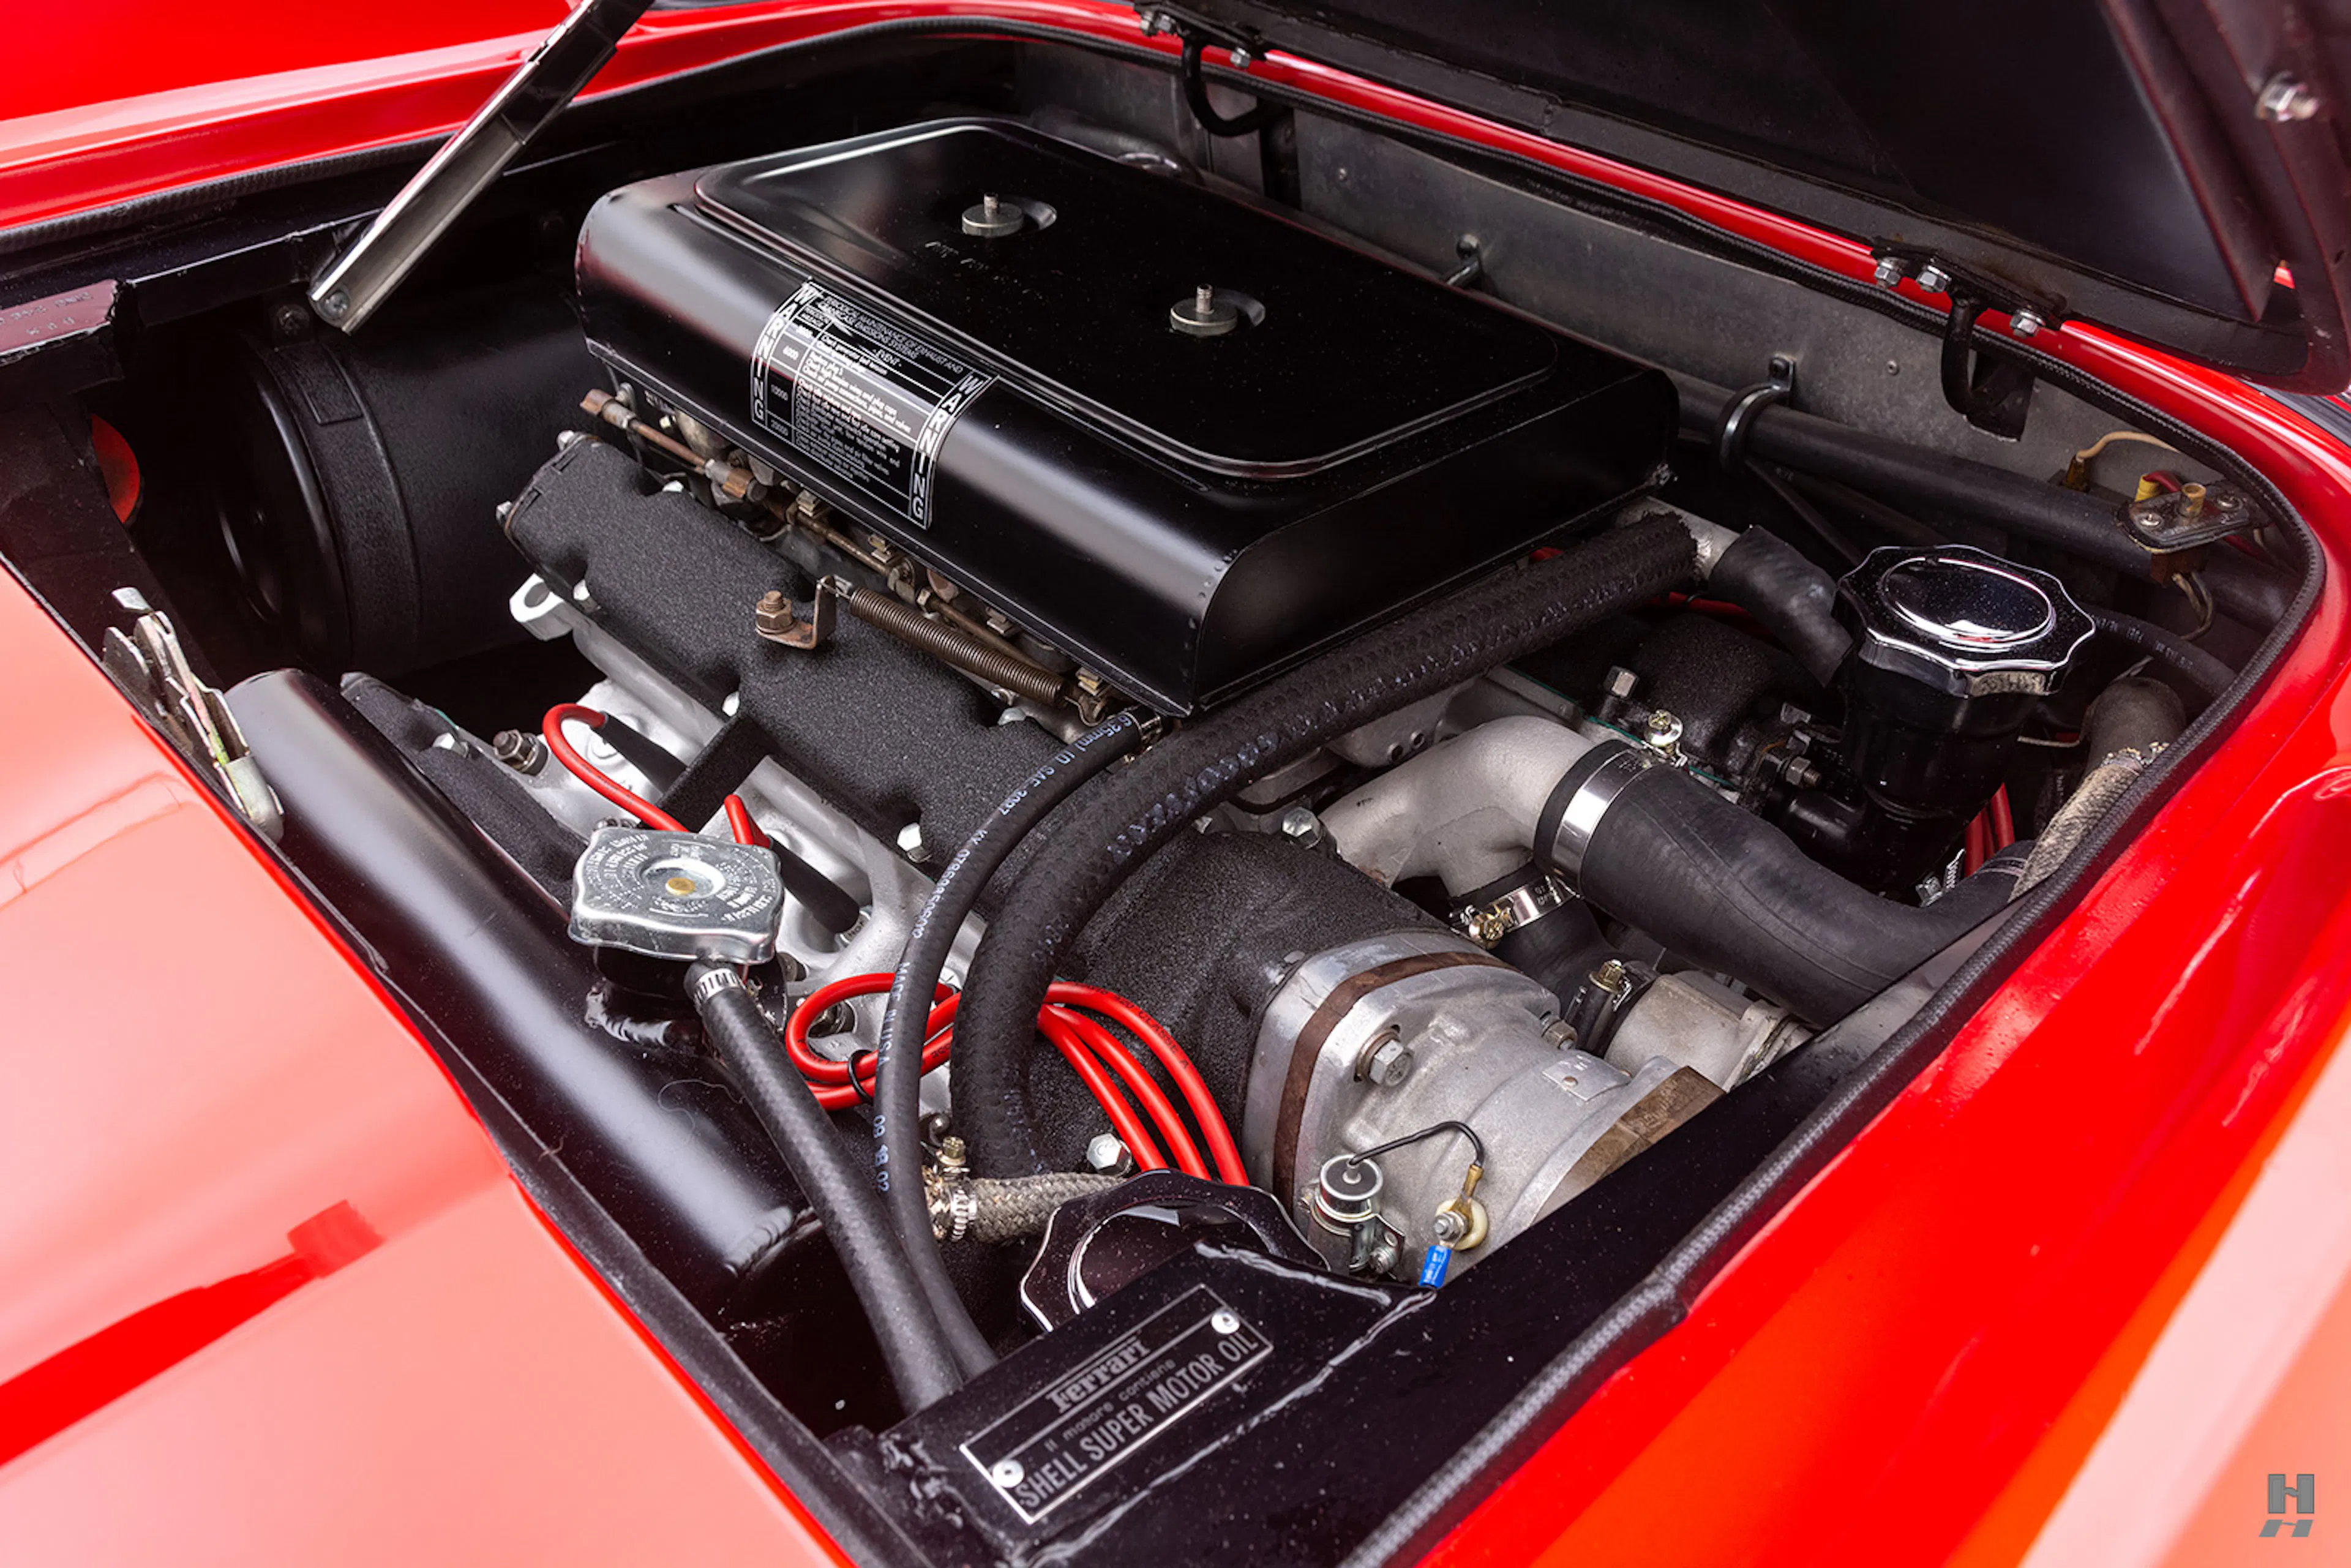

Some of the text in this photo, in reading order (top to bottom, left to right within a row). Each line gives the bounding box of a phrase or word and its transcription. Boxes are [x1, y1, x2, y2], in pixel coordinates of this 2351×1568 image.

[753, 283, 819, 420] WARNING
[912, 374, 984, 520] WARNING
[1032, 766, 1056, 787] SAE
[891, 961, 910, 1002] MADE
[1046, 1336, 1152, 1414] Ferrari
[1063, 1402, 1114, 1438] motore
[1119, 1358, 1177, 1401] contiene
[1015, 1331, 1259, 1508] SHELL SUPER MOTOR OIL
